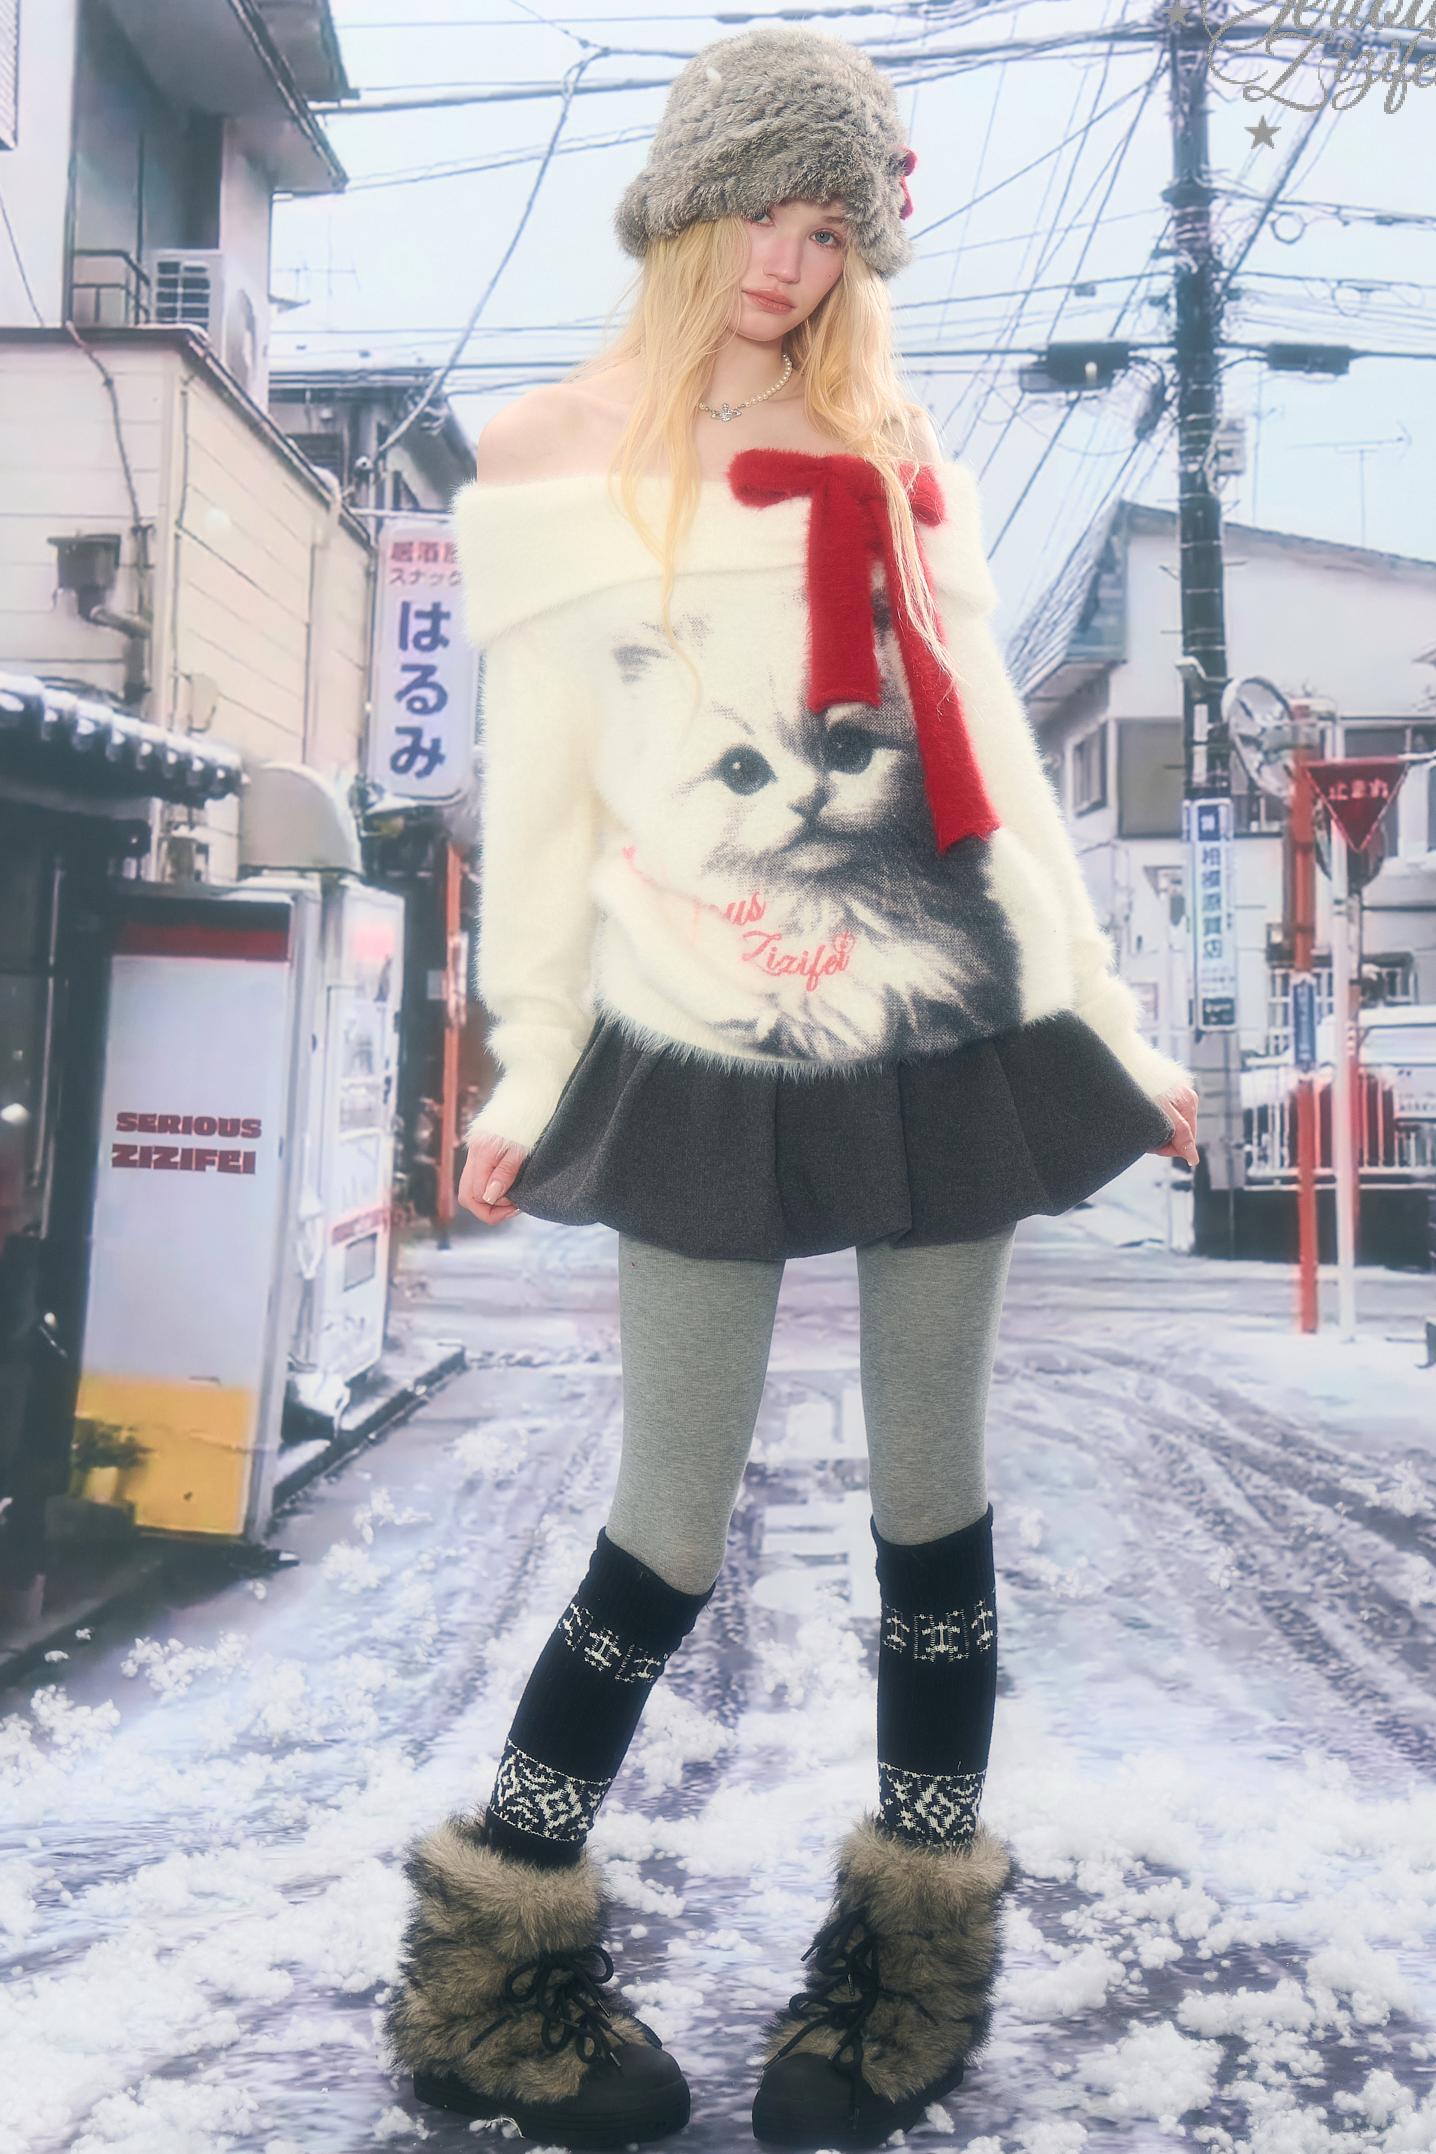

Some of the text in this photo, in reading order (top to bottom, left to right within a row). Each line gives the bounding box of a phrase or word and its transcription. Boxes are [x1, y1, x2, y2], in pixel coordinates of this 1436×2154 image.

[390, 601, 451, 778] はるみ
[116, 1111, 262, 1139] SERIOUS
